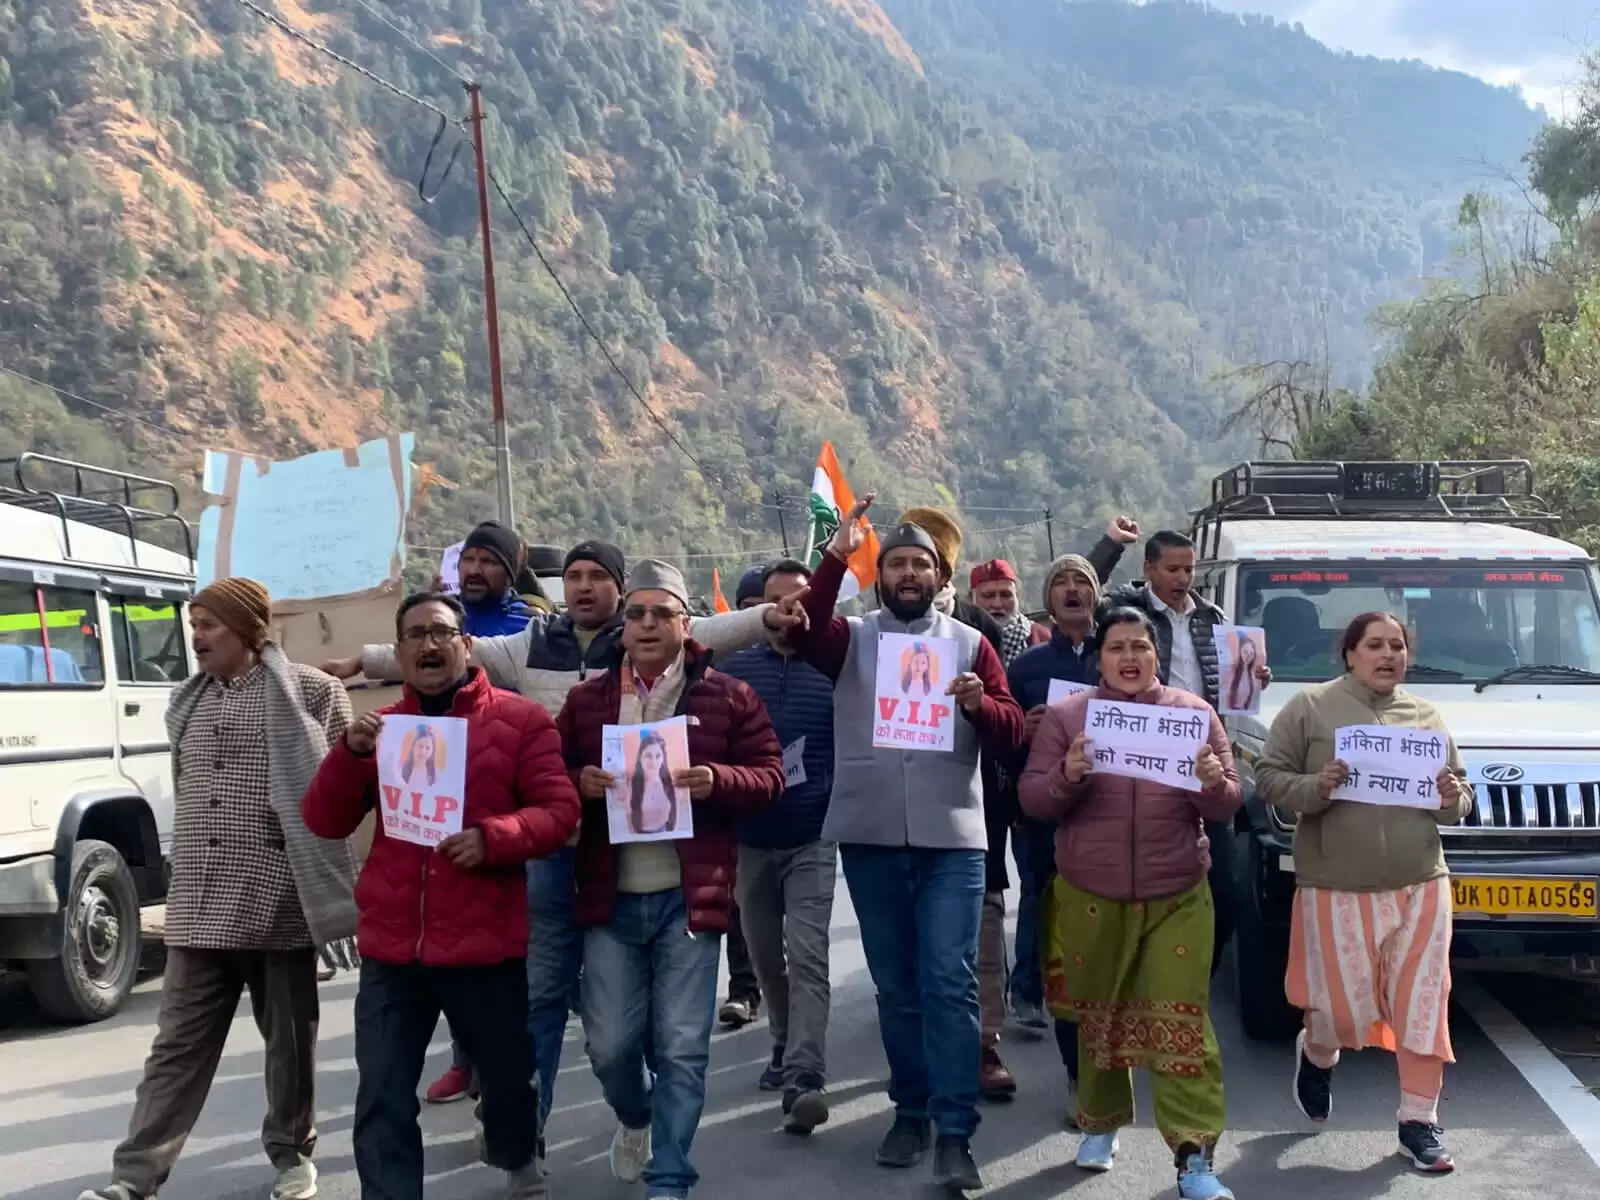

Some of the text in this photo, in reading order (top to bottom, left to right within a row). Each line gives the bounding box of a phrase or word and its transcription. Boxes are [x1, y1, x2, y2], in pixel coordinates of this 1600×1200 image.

[878, 696, 950, 728] V.I.P
[1091, 705, 1204, 740] अंकिता भंडारी
[1339, 729, 1442, 760] अंकिता भंडारी
[1095, 746, 1196, 777] को न्याय दो
[1368, 773, 1410, 794] न्याय
[1417, 775, 1434, 799] दो
[382, 785, 458, 822] V.I.P
